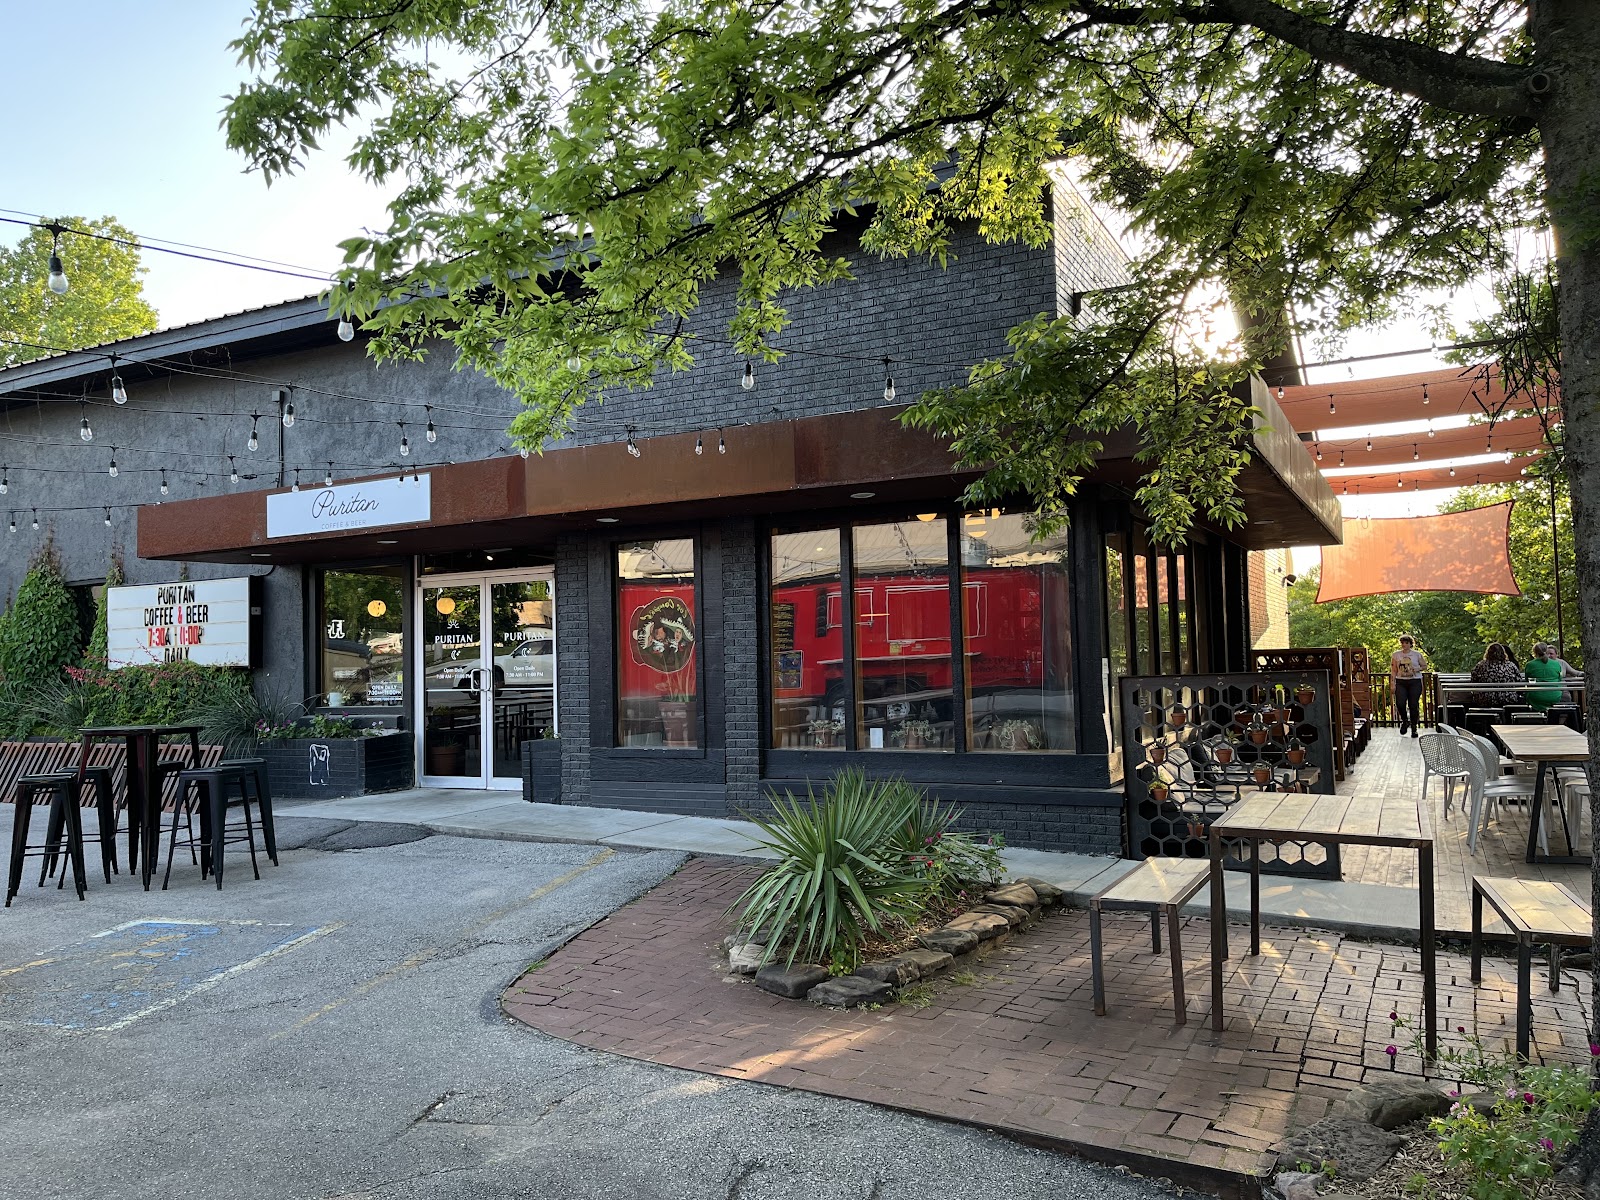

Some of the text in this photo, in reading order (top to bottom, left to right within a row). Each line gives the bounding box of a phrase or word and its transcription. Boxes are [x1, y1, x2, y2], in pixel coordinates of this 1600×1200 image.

[312, 490, 379, 518] Puritan
[321, 521, 343, 530] COFFEE
[158, 584, 195, 605] PURITAN
[144, 604, 208, 626] COFFEE & BEER
[434, 634, 472, 644] PURITAN
[504, 631, 544, 641] PURITAN
